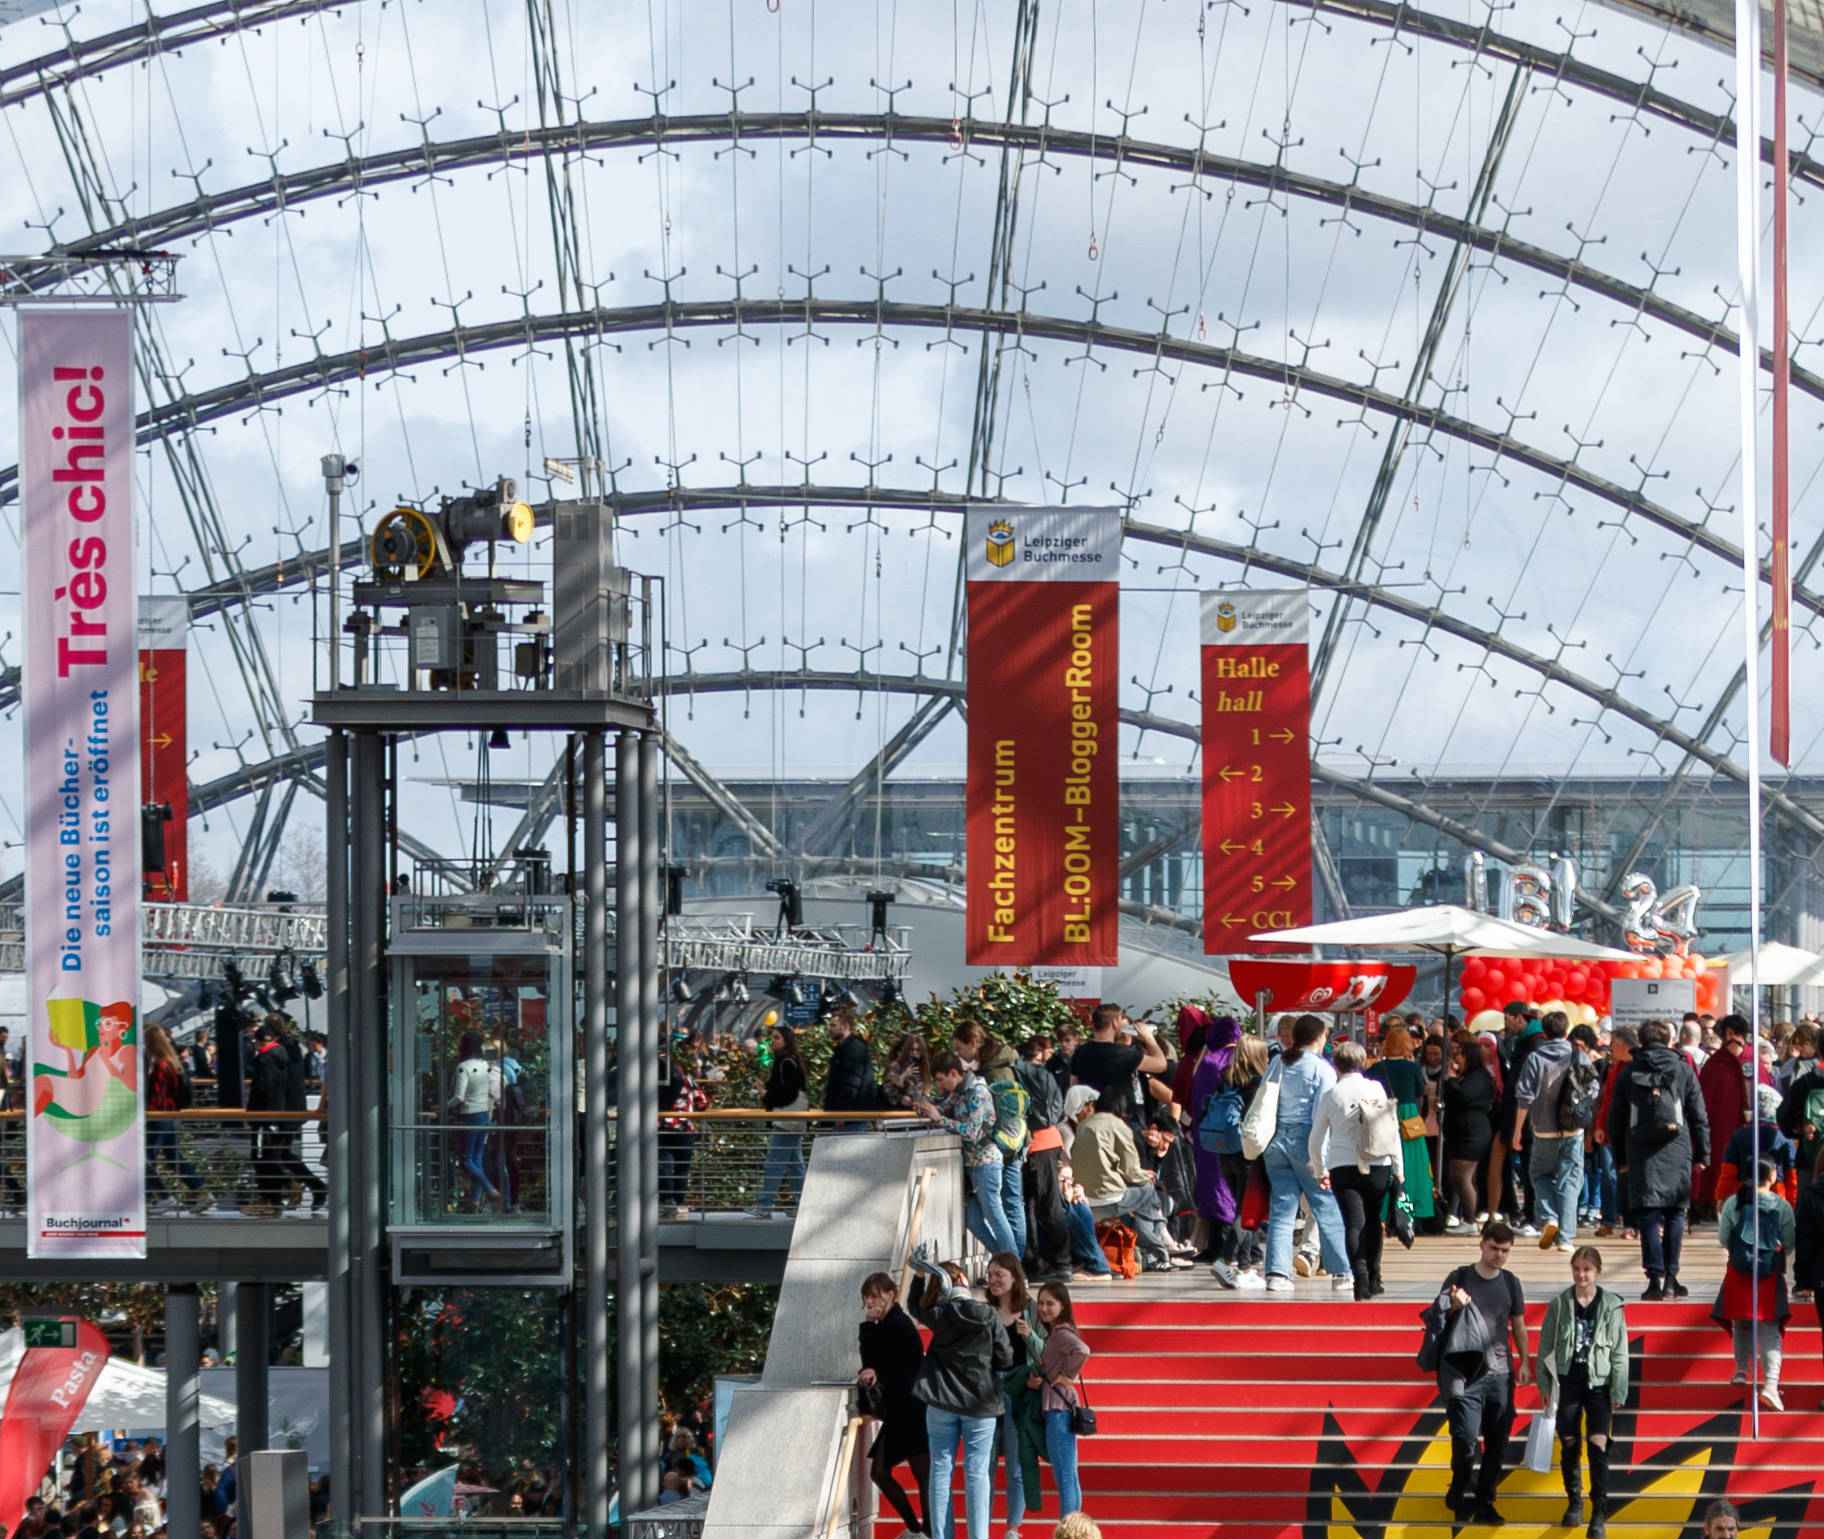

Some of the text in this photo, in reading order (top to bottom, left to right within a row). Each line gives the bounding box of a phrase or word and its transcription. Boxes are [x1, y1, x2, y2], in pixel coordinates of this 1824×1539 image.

[51, 366, 109, 677] Très chic!
[1024, 535, 1088, 552] Leipziger
[1024, 550, 1102, 563] Buchmesse
[1216, 657, 1280, 678] Halle
[1216, 691, 1262, 712] hall
[1251, 729, 1261, 745] 1
[1250, 766, 1263, 782] 2
[85, 689, 111, 937] saison ist eröffnet
[1251, 802, 1263, 818] 3
[988, 738, 1016, 943] Fachzentrum
[1251, 839, 1264, 855] 4
[58, 739, 82, 972] Die neue Bücher-
[1251, 876, 1263, 892] 5
[1251, 912, 1296, 929] CCL
[46, 1217, 122, 1230] Buchjournal
[49, 1350, 96, 1410] Pasta
